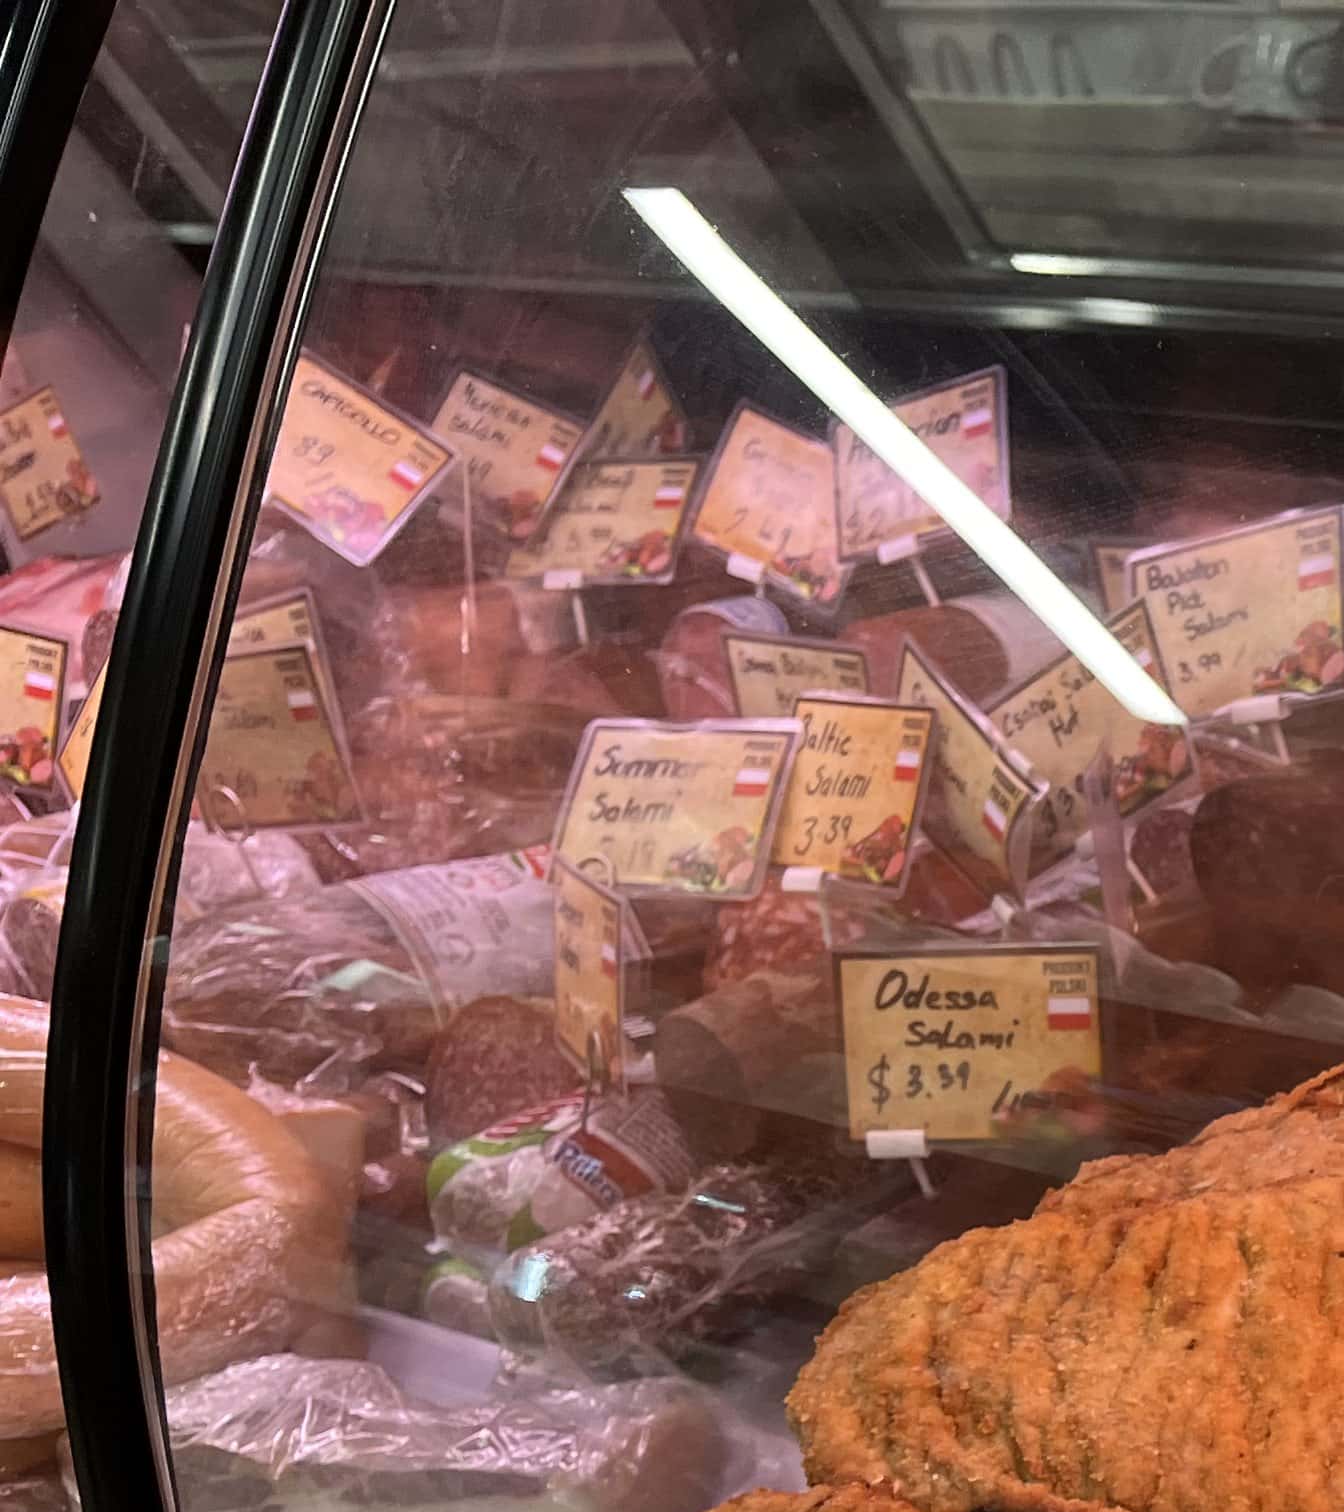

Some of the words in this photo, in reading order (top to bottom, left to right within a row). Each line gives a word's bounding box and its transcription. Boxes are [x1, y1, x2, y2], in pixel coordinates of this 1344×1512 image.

[806, 765, 872, 799] Salami
[875, 968, 999, 1011] Odessa
[904, 1018, 1020, 1051] Salami
[867, 1053, 892, 1115] $
